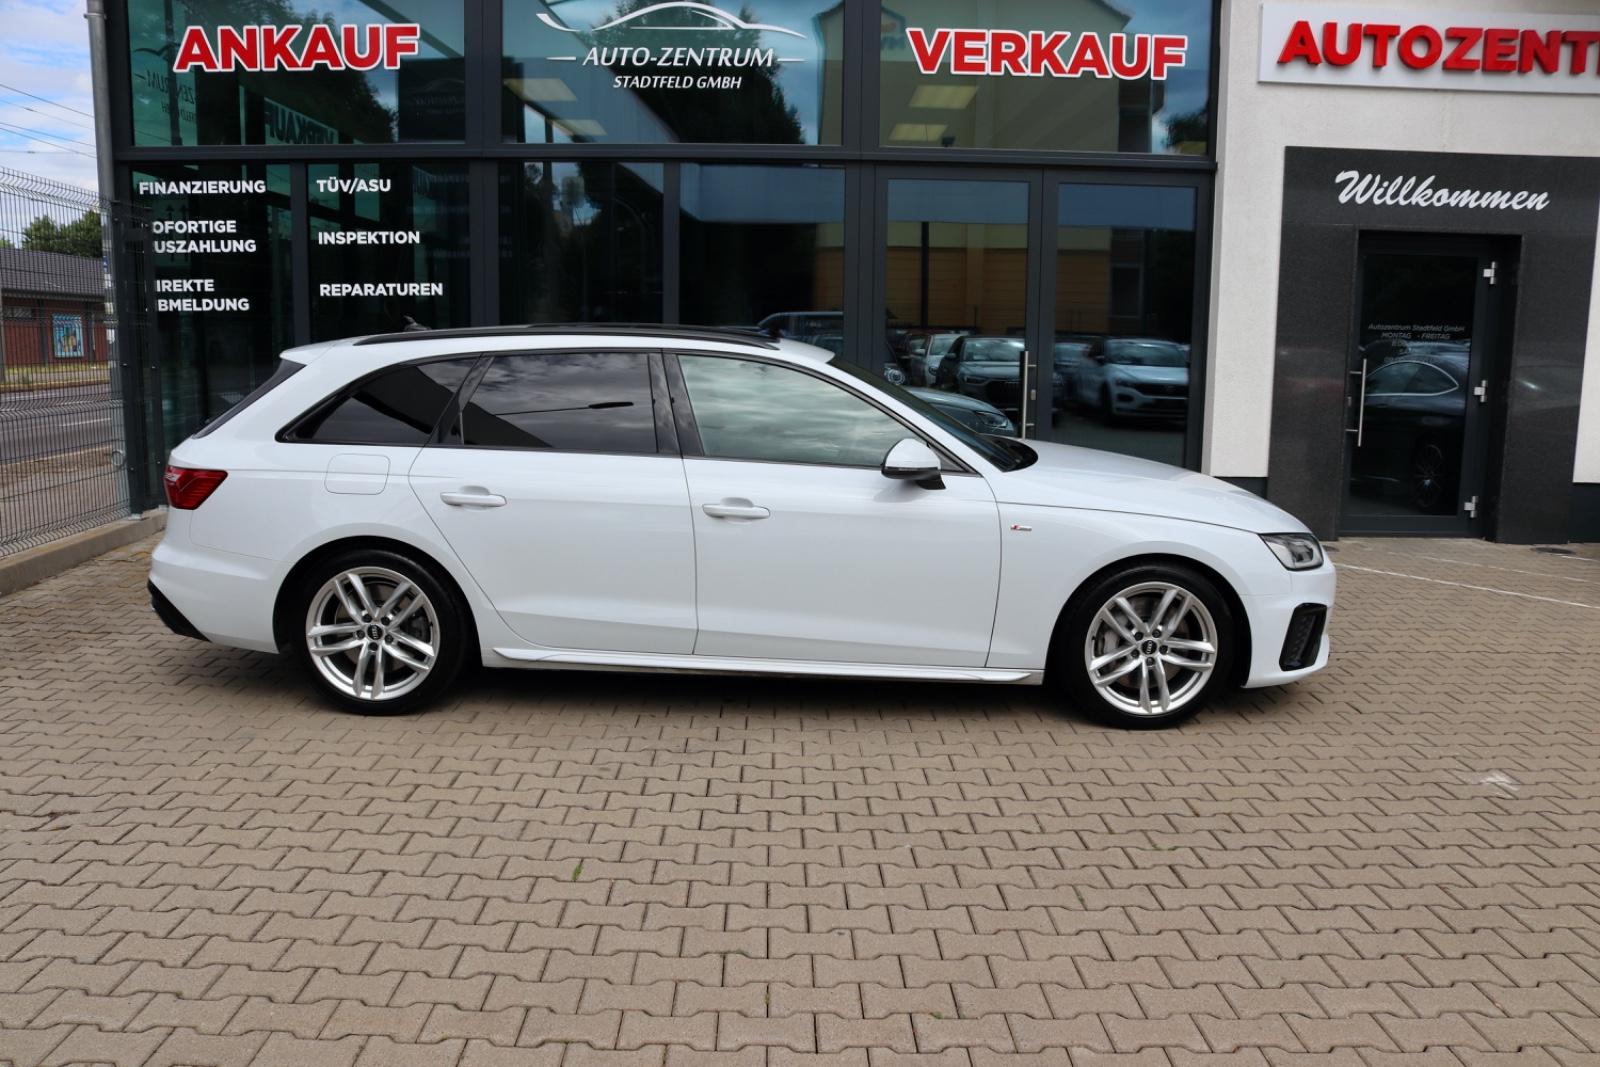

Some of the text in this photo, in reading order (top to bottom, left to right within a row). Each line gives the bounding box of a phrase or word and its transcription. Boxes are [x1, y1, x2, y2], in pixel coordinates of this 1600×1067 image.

[173, 24, 420, 72] ANKAUF
[906, 27, 1188, 80] VERKAUF
[1277, 20, 1600, 75] AUTOZENT
[583, 46, 774, 68] AUTO-ZENTRUM
[613, 75, 742, 90] STADTFELD GMBH
[139, 179, 267, 195] FINANZIERUNG
[316, 177, 391, 194] TÜV/ASU
[1335, 170, 1550, 211] Willkommen
[152, 220, 237, 234] OFORTIGE
[154, 239, 257, 254] USZAHLUNG
[318, 231, 420, 246] INSPEKTION
[156, 279, 215, 293] IREKTE
[319, 282, 444, 298] REPARATUREN
[158, 298, 250, 312] BMELDUNG
